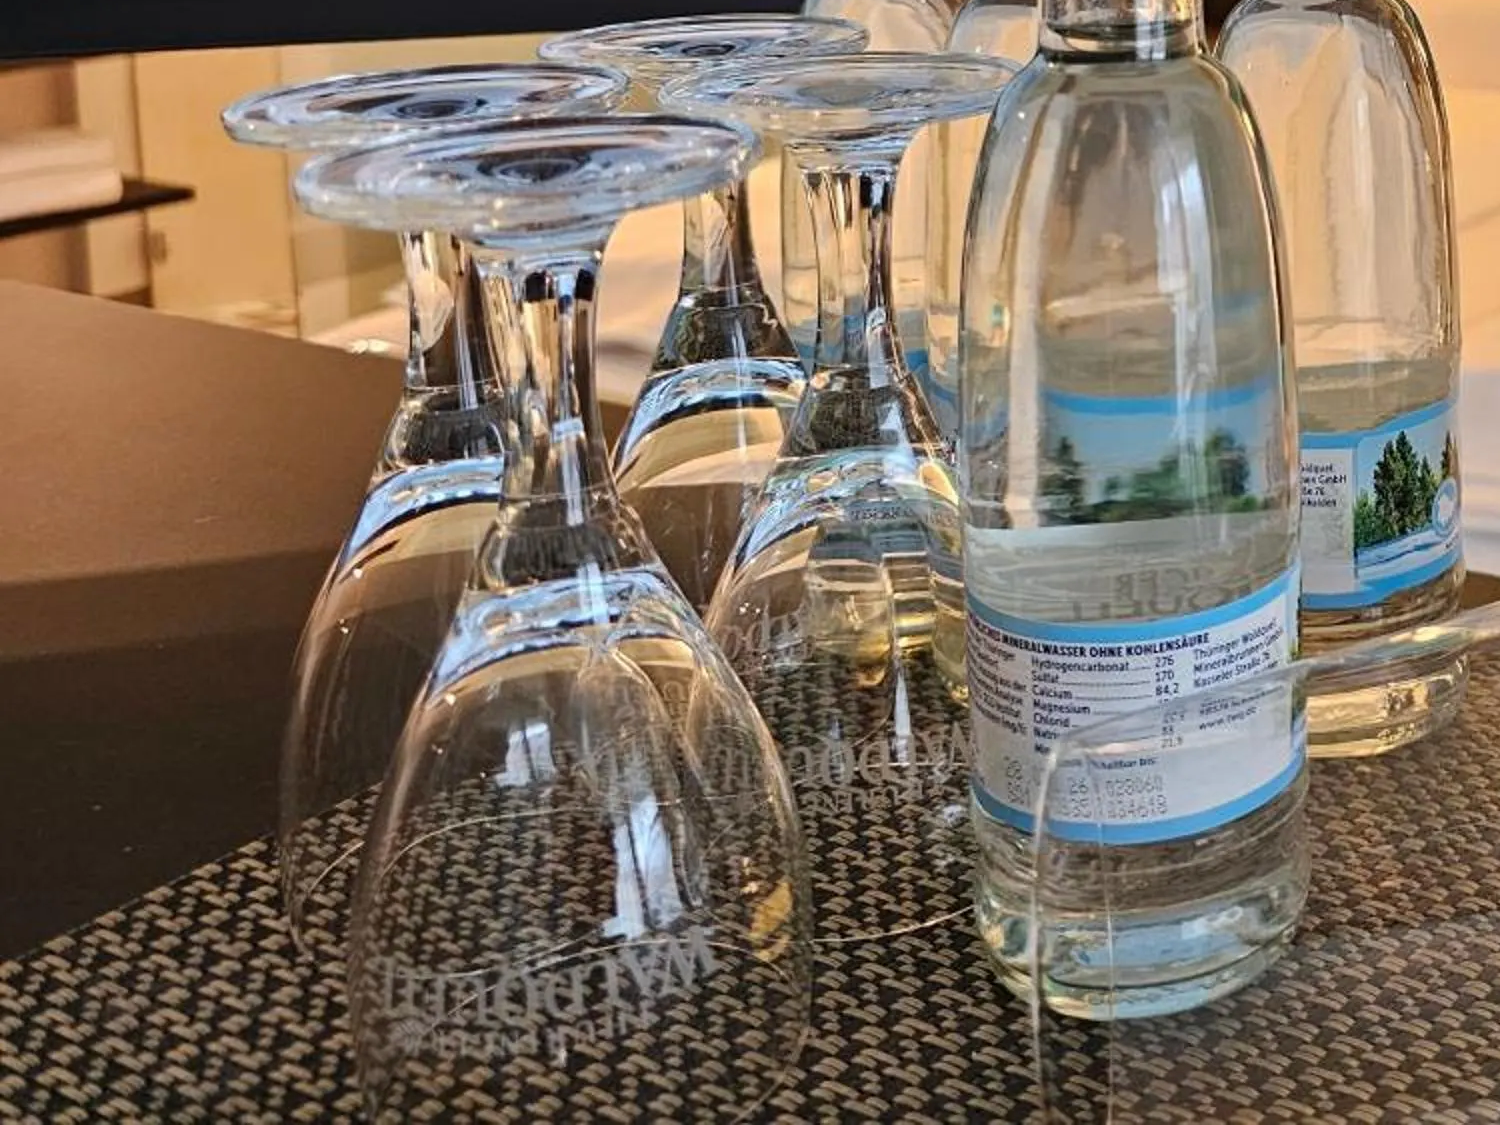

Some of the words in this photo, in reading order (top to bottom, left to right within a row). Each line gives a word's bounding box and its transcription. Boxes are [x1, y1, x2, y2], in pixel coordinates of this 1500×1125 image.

[1002, 634, 1086, 657] MINERALWASSER
[1089, 646, 1123, 658] OHNE
[1126, 632, 1210, 657] KOHLENSÄURE
[1031, 655, 1129, 674] Hydrogencarbonat
[1155, 656, 1175, 668] 276
[1155, 670, 1175, 682] 170
[1032, 685, 1073, 699] Calcium
[1033, 698, 1090, 715] Magnesium
[1034, 712, 1070, 727] Chlorid
